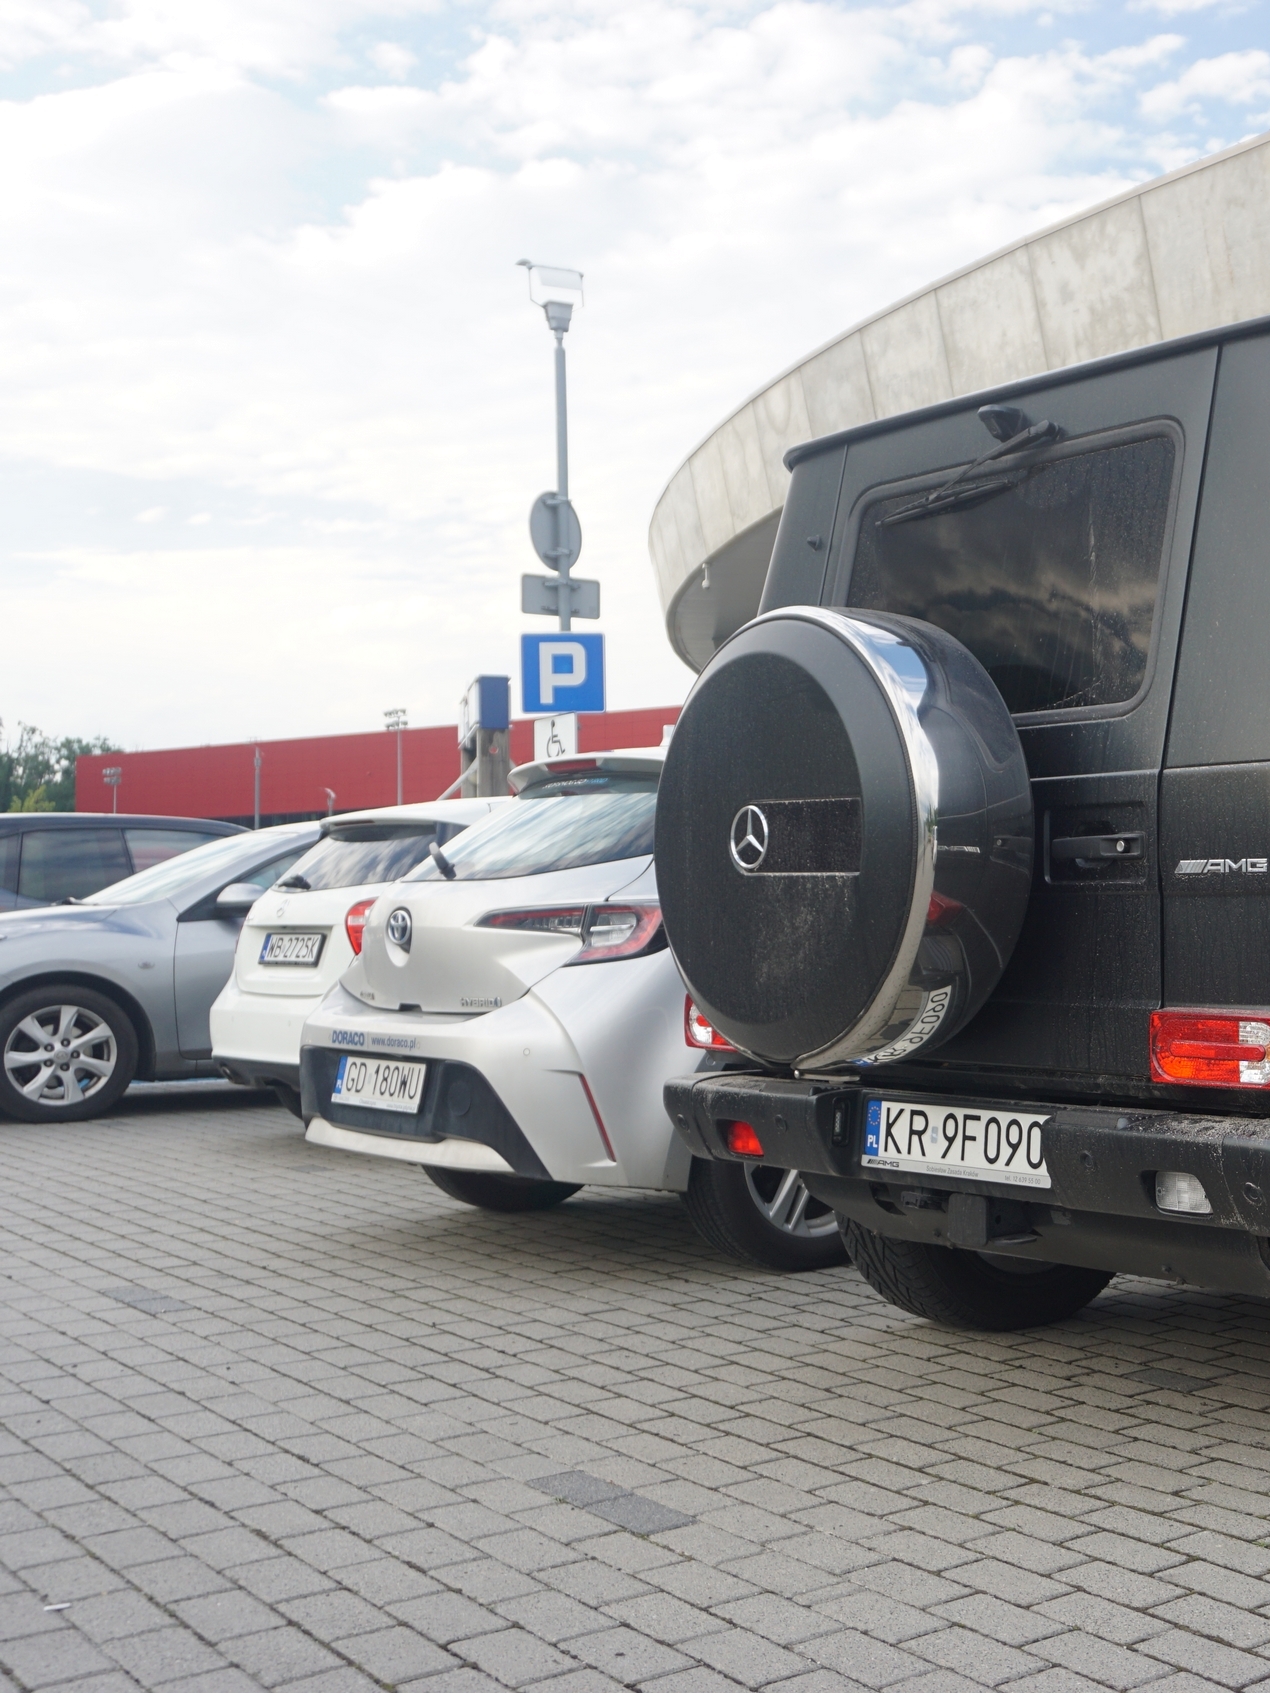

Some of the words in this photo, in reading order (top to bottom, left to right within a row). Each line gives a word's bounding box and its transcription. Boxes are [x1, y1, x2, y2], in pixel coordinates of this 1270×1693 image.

[538, 641, 586, 704] P
[266, 937, 284, 958] WB
[283, 937, 320, 959] 2725K
[331, 1029, 365, 1047] DORACO
[371, 1036, 417, 1051] www.doraco.pl
[345, 1061, 368, 1093] GD
[372, 1063, 422, 1100] 180WU
[867, 1134, 878, 1148] PL
[884, 1107, 930, 1157] KR
[941, 1112, 1044, 1169] 9F090
[946, 1167, 963, 1176] Zasada
[963, 1169, 979, 1177] Kraków
